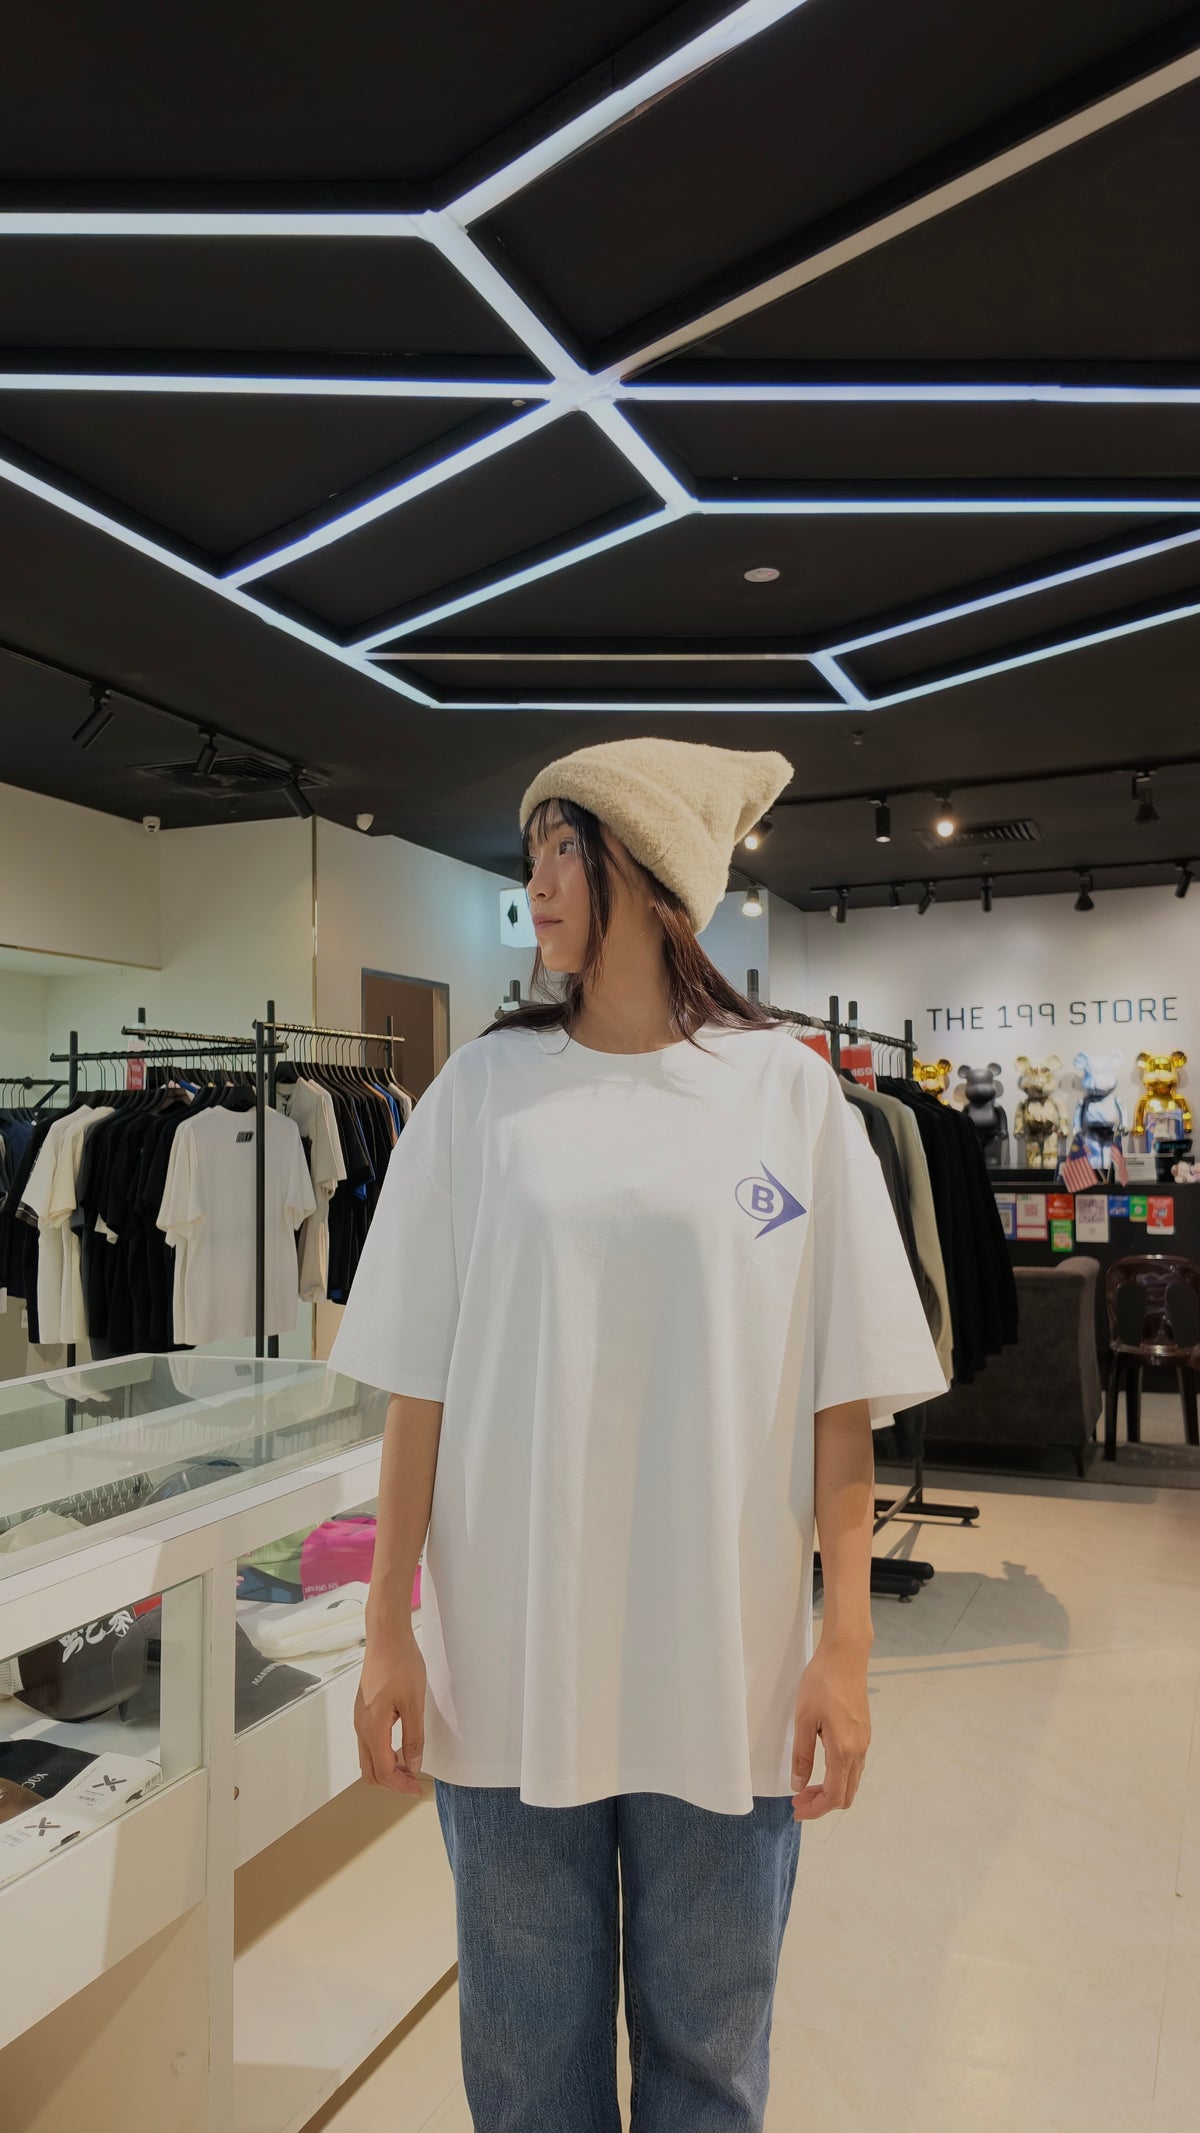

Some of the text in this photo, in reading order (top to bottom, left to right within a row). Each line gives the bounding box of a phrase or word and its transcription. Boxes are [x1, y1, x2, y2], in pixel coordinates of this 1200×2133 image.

[926, 996, 1178, 1031] THE 199 STORE
[751, 1183, 775, 1214] B
